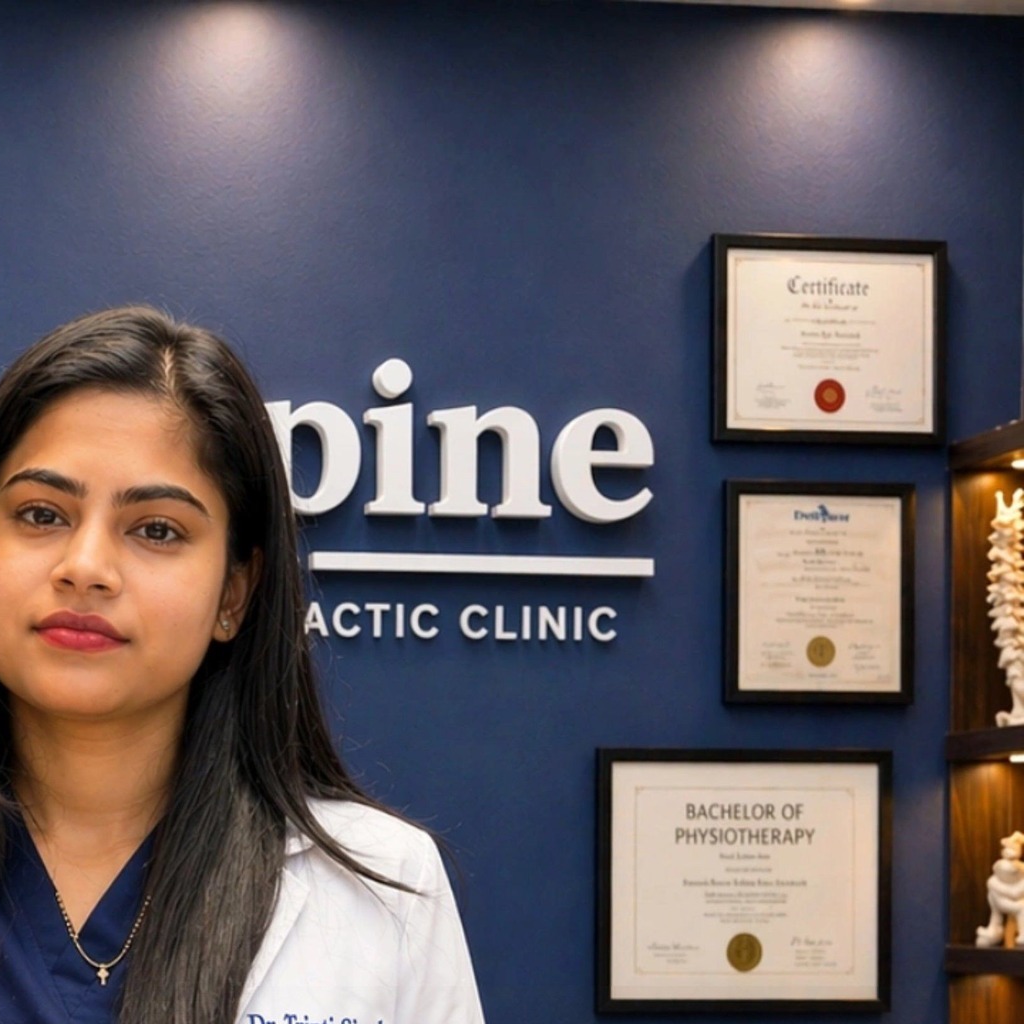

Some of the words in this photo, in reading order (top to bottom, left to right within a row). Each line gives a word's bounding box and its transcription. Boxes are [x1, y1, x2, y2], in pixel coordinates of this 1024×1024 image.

[786, 275, 870, 297] Certificate
[263, 358, 654, 524] pine
[304, 601, 439, 639] ACTIC
[459, 605, 618, 641] CLINIC
[685, 803, 776, 820] BACHELOR
[781, 803, 804, 821] OF
[675, 827, 816, 845] PHYSIOTHERAPY
